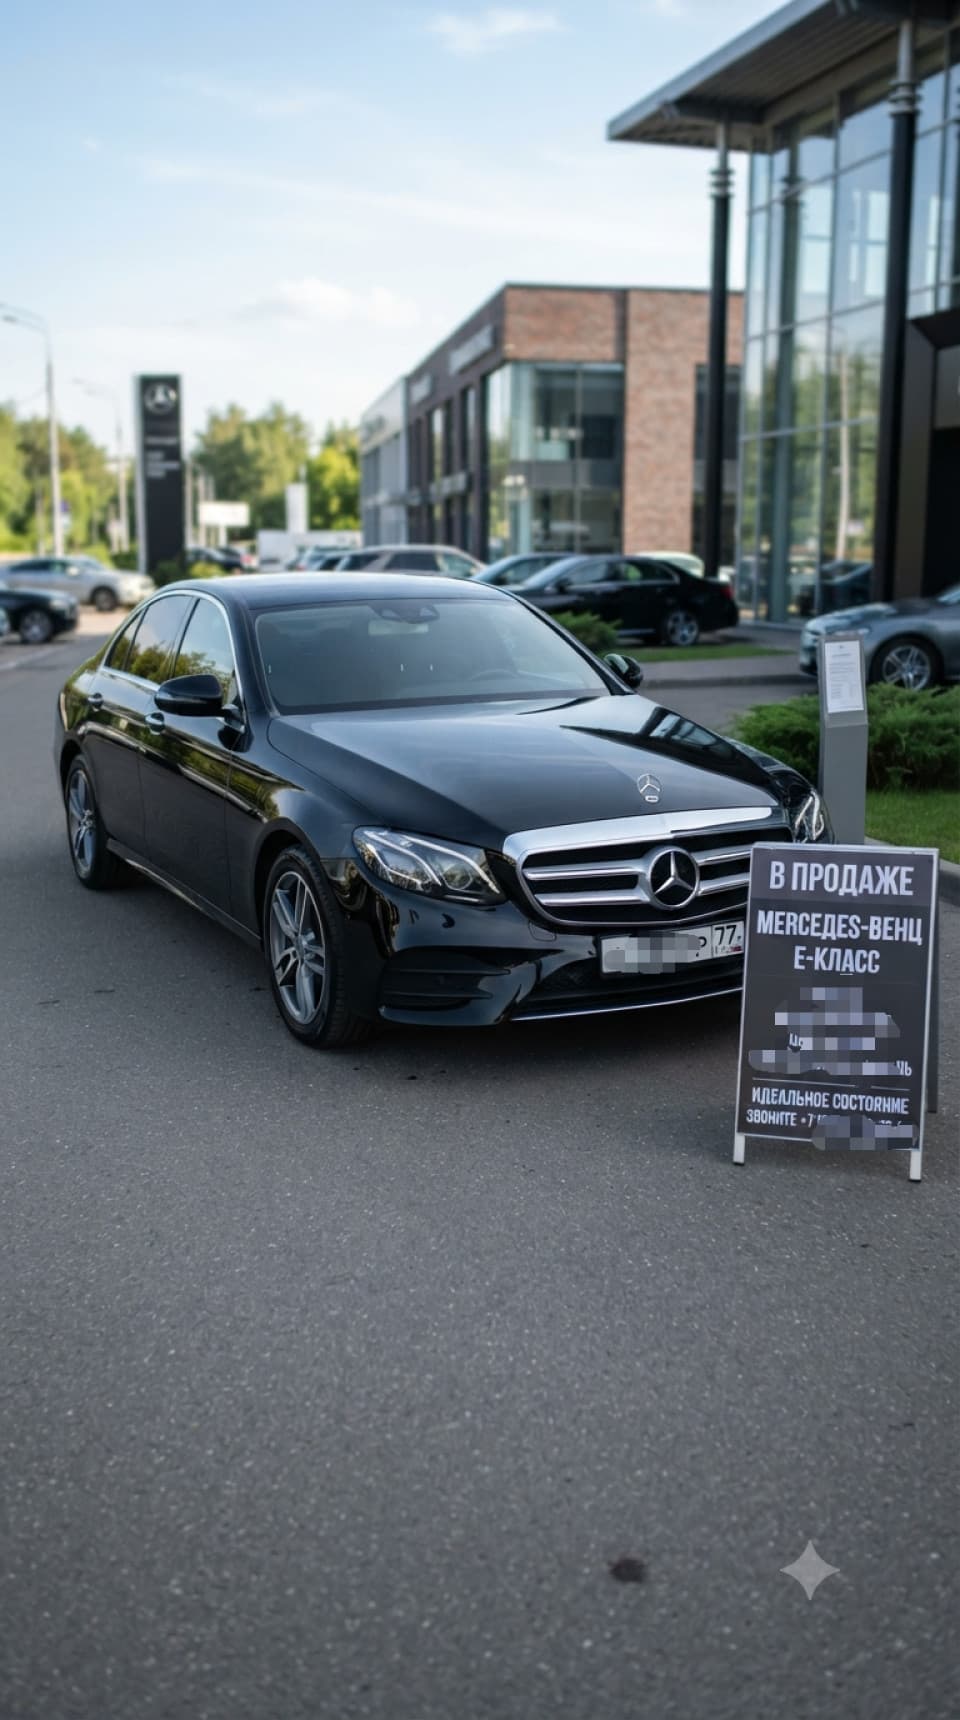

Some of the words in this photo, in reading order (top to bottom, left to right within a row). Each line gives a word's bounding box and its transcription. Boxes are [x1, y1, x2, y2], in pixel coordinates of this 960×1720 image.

[769, 861, 785, 889] В
[791, 862, 914, 897] ПРОДАЖЕ
[715, 925, 736, 945] 77
[793, 945, 880, 973] Е-КЛАСС
